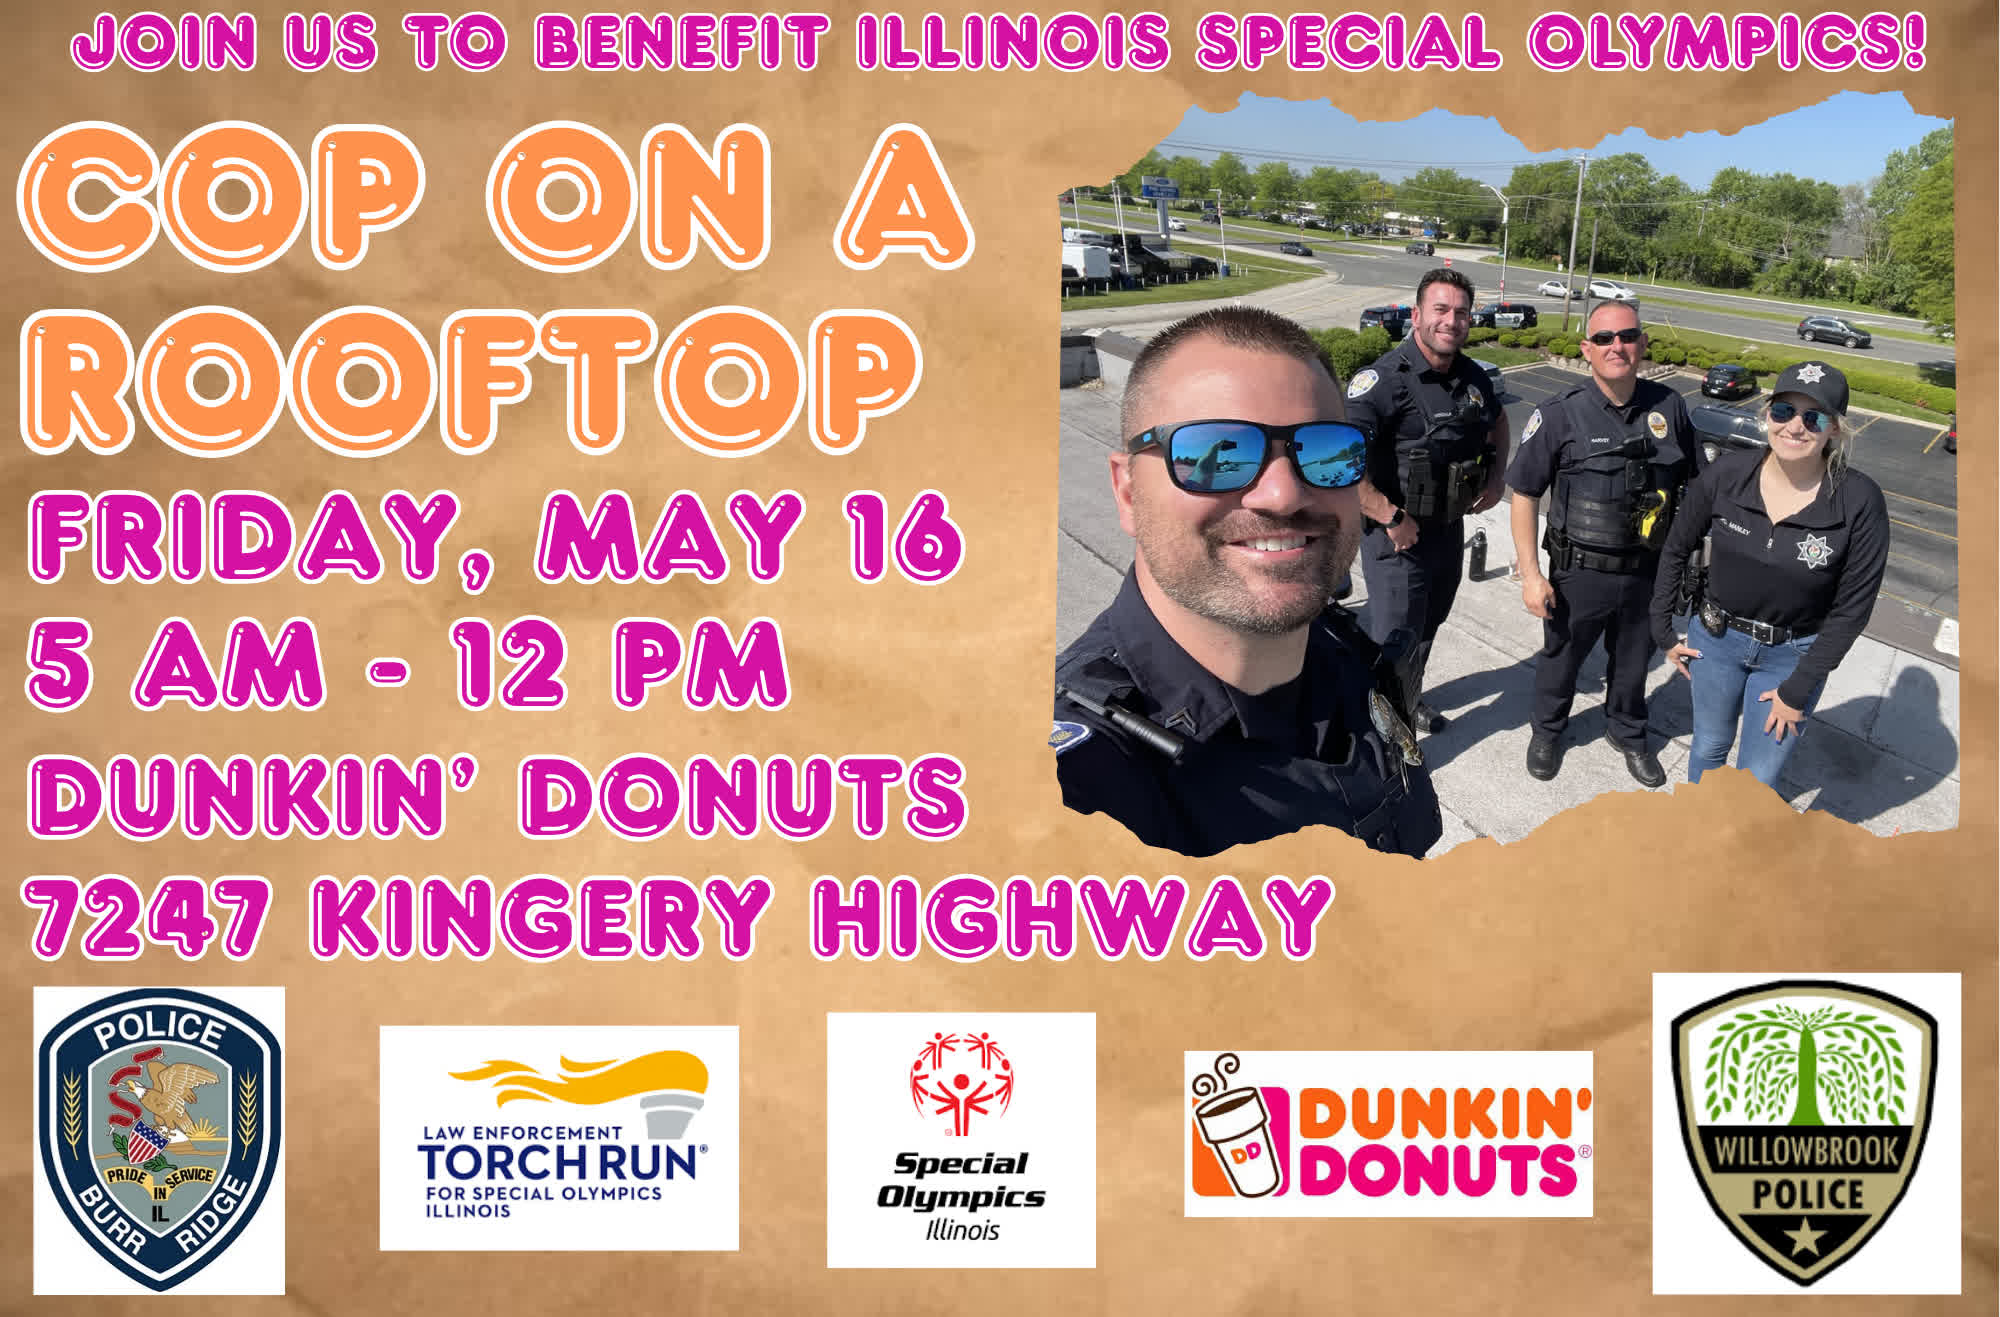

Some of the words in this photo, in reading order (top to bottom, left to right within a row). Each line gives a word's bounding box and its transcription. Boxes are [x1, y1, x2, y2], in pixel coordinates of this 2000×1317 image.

[70, 12, 256, 72] JOIN
[284, 12, 378, 72] US
[402, 12, 508, 72] TO
[534, 13, 831, 71] BENEFIT
[856, 12, 1171, 72] ILLINOIS
[1196, 12, 1503, 72] SPECIAL
[1527, 12, 1926, 72] OLYMPICS!
[18, 122, 424, 271] COP
[487, 122, 769, 271] ON
[835, 125, 974, 268] A
[22, 307, 921, 456] ROOFTOP
[29, 491, 493, 594] FRIDAY,
[535, 490, 805, 584] MAY
[843, 490, 965, 585] 16
[25, 618, 92, 712] 5
[131, 618, 326, 710] AM
[367, 658, 410, 686] -
[450, 616, 567, 710] 12
[612, 618, 790, 711] PM
[28, 753, 478, 841] DUNKIN’
[519, 754, 968, 841] DONUTS
[21, 875, 272, 960] 7247
[310, 875, 774, 962] KINGERY
[811, 875, 1335, 962] HIGHWAY
[93, 1010, 227, 1050] POLICE
[1299, 1087, 1592, 1140] DUNKIN'
[424, 1126, 465, 1140] LAW
[473, 1126, 623, 1140] ENFORCEMENT
[1714, 1136, 1899, 1166] WILLOWBROOK
[417, 1144, 587, 1180] TORCH
[599, 1144, 696, 1180] RUN
[894, 1152, 1029, 1180] Special
[1230, 1142, 1261, 1164] DD
[1299, 1144, 1578, 1198] DONUTS
[107, 1168, 148, 1184] PRIDE
[154, 1187, 167, 1200] IN
[165, 1168, 214, 1189] SERVICE
[426, 1187, 466, 1201] FOR
[473, 1187, 554, 1201] SPECIAL
[562, 1187, 662, 1201] OLYMPICS
[877, 1185, 1046, 1213] Olympics
[1753, 1179, 1864, 1210] POLICE
[78, 1183, 147, 1256] BURR
[175, 1174, 248, 1254] RIDGE
[152, 1205, 170, 1223] IL
[426, 1204, 511, 1218] ILLINOIS
[926, 1218, 1000, 1241] Illinois
